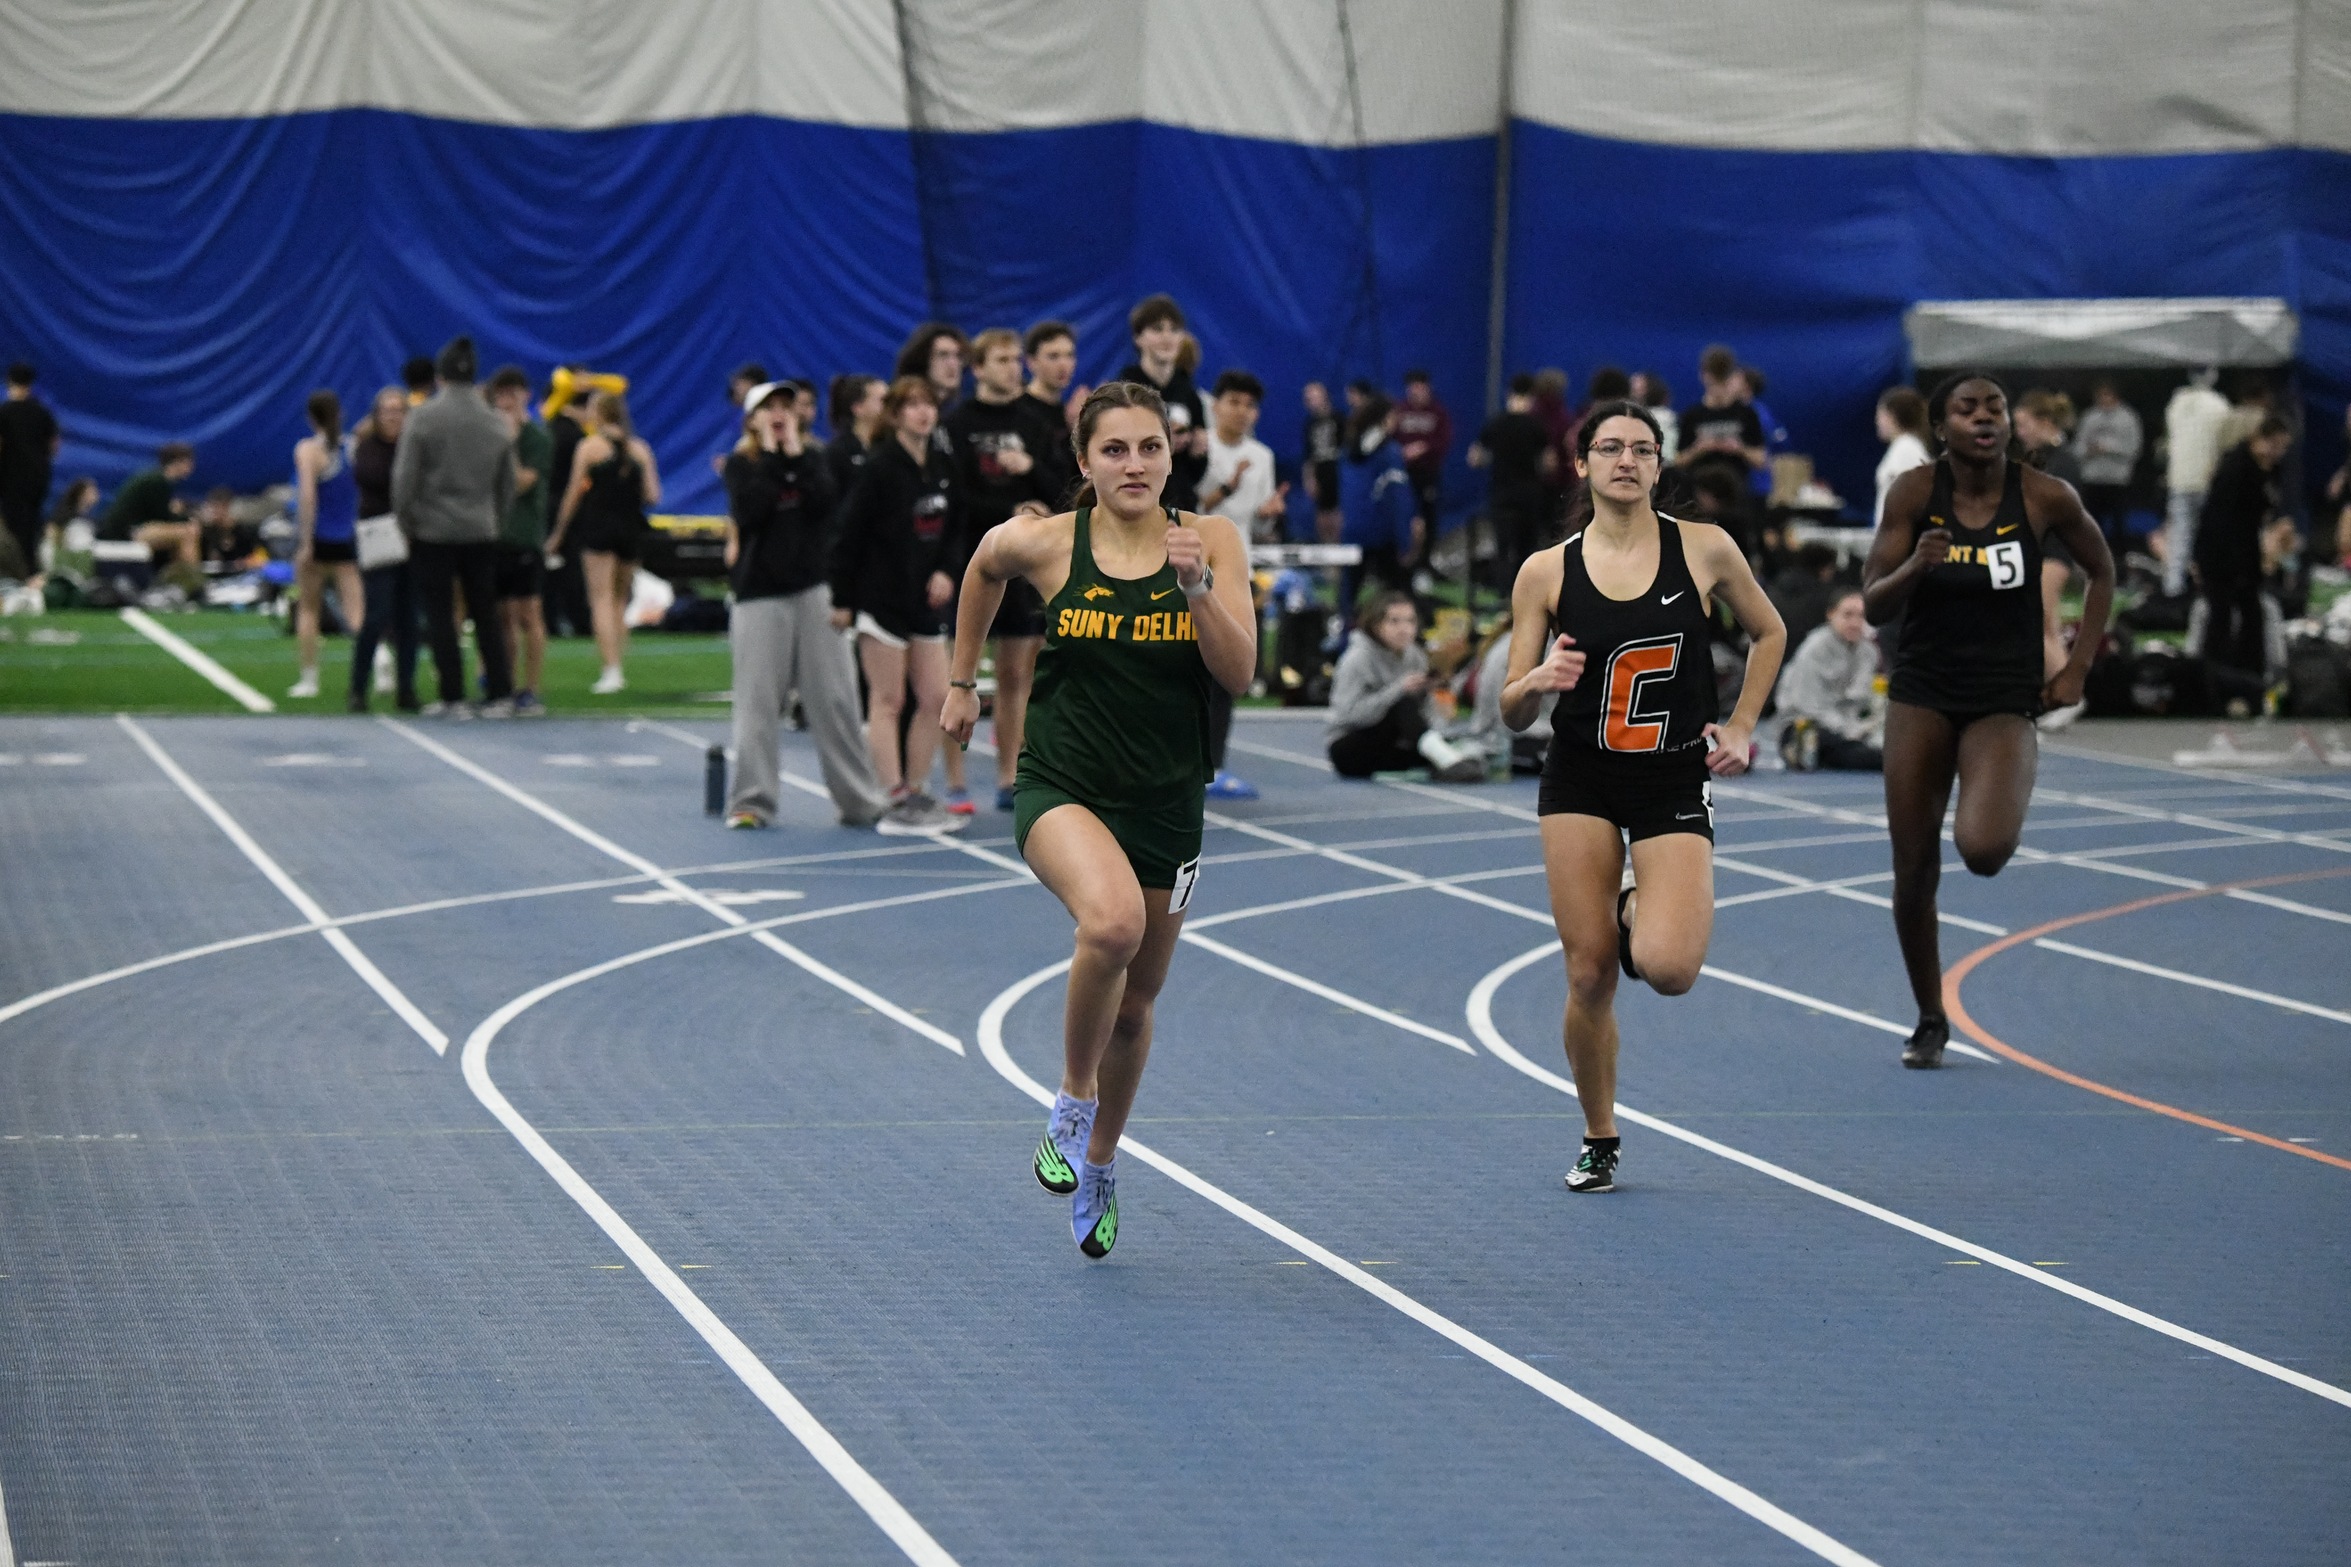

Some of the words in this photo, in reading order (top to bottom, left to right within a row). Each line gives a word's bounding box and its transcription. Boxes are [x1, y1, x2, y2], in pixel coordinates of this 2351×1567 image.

[1996, 546, 2017, 585] 5
[1057, 608, 1124, 640] SUNY
[1598, 632, 1684, 753] C
[1179, 859, 1198, 909] 7
